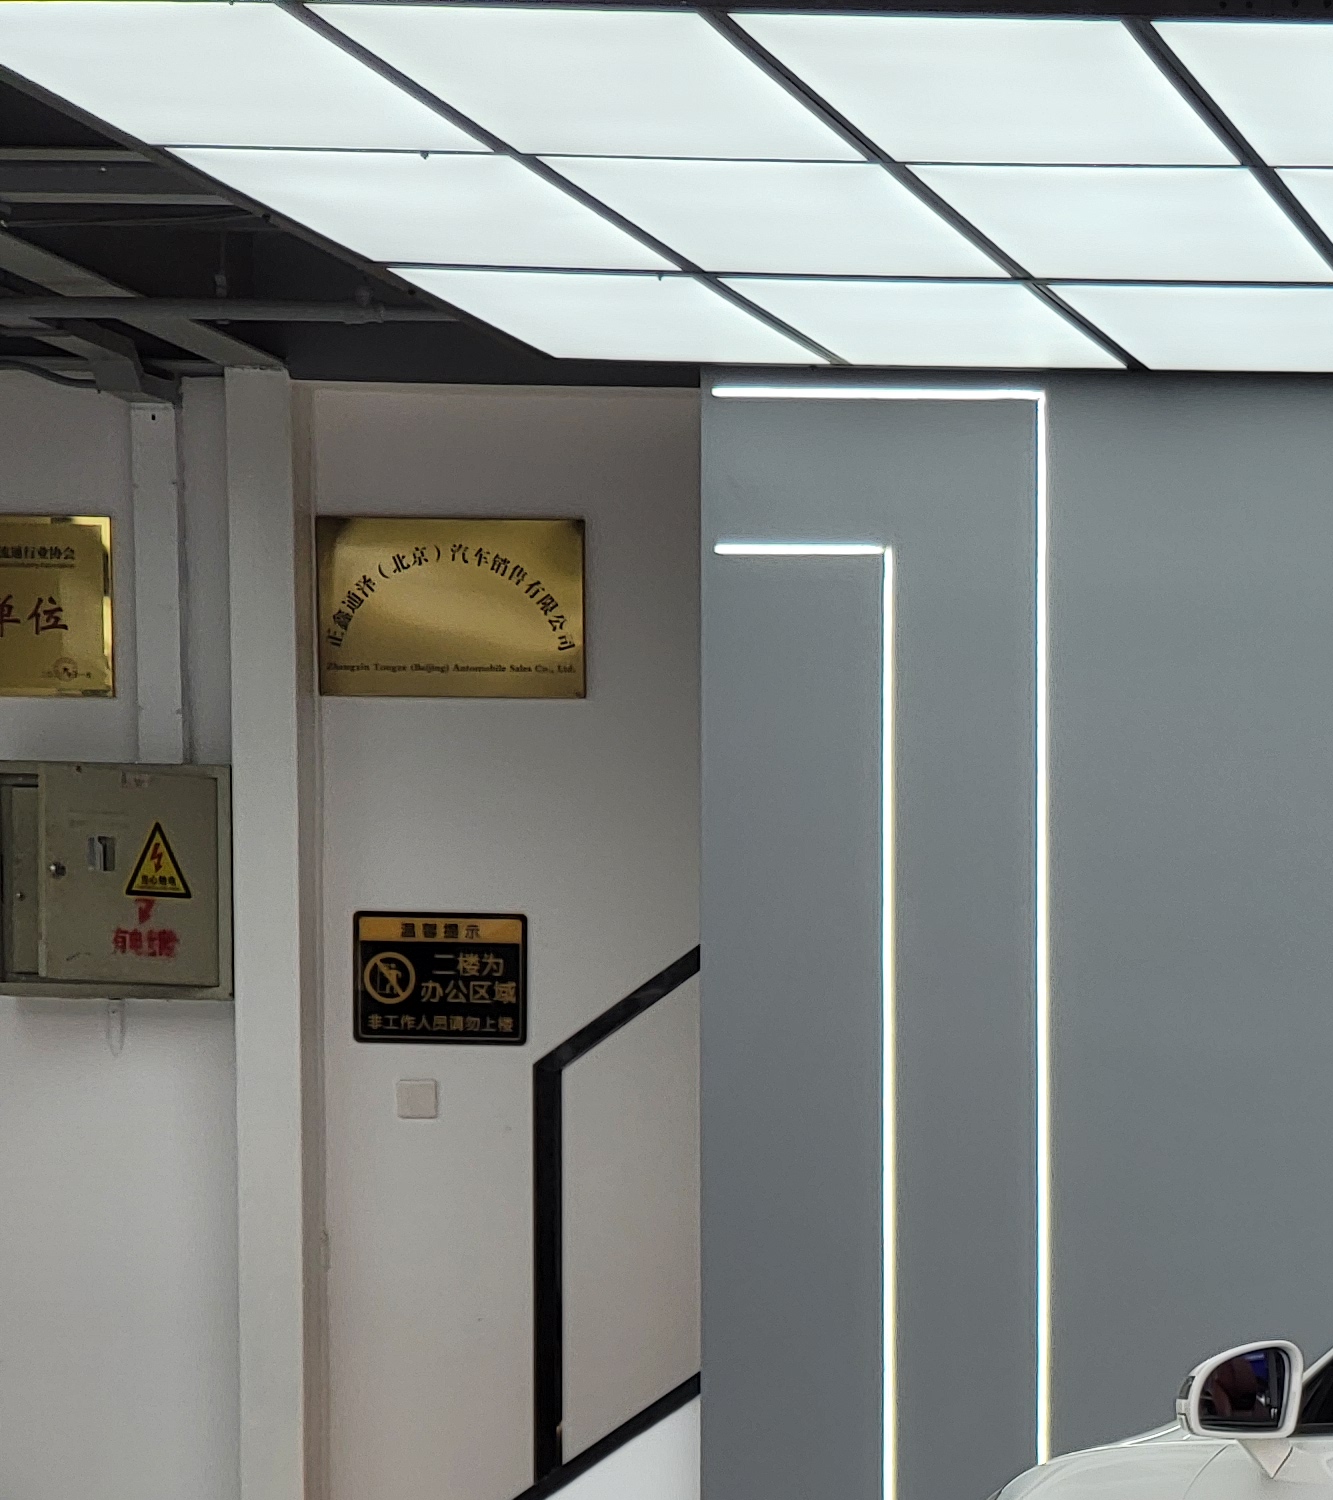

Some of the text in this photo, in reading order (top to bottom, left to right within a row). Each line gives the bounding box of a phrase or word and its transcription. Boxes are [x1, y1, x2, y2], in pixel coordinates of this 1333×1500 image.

[510, 664, 532, 672] Sales
[432, 952, 504, 977] 二楼为
[421, 980, 517, 1004] 办公区域
[368, 1013, 514, 1033] 非工作人员请勿上楼
